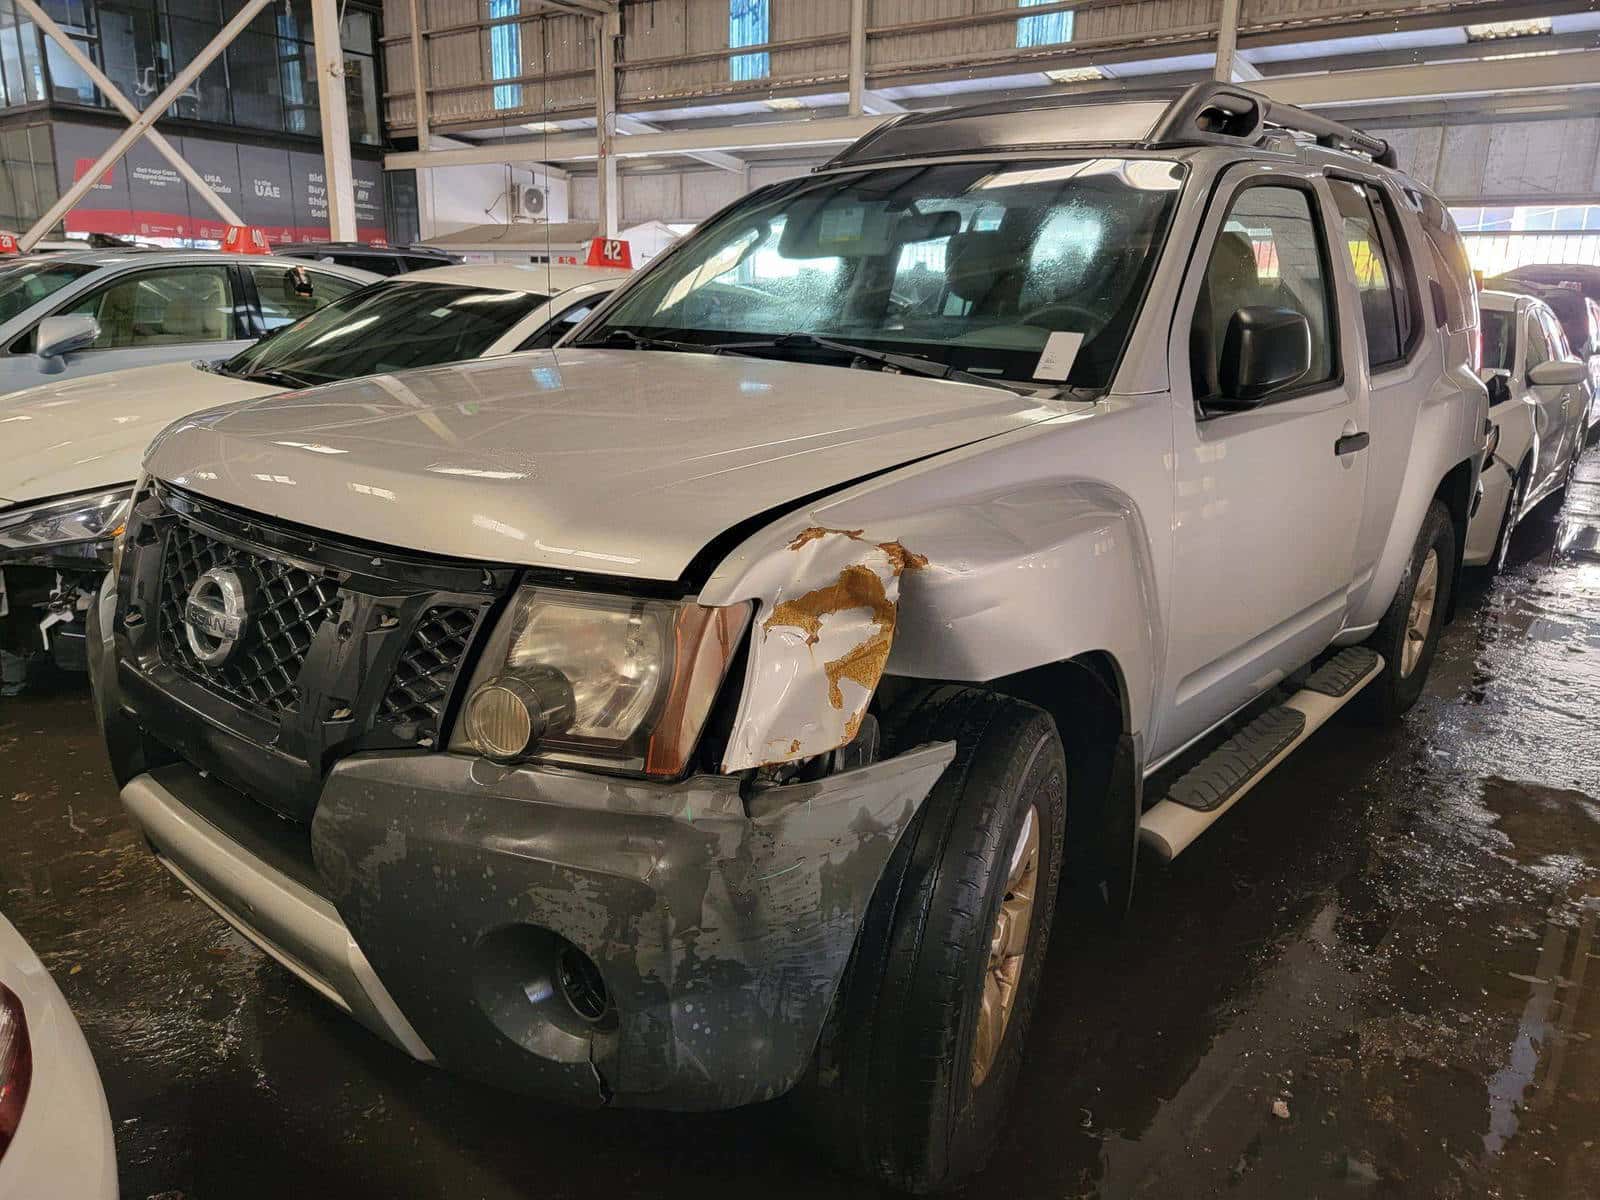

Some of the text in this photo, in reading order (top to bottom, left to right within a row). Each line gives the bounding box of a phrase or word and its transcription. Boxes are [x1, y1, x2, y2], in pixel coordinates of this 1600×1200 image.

[309, 174, 323, 183] Bid
[255, 185, 281, 198] UAE
[308, 185, 325, 197] Buy
[604, 241, 622, 260] 42
